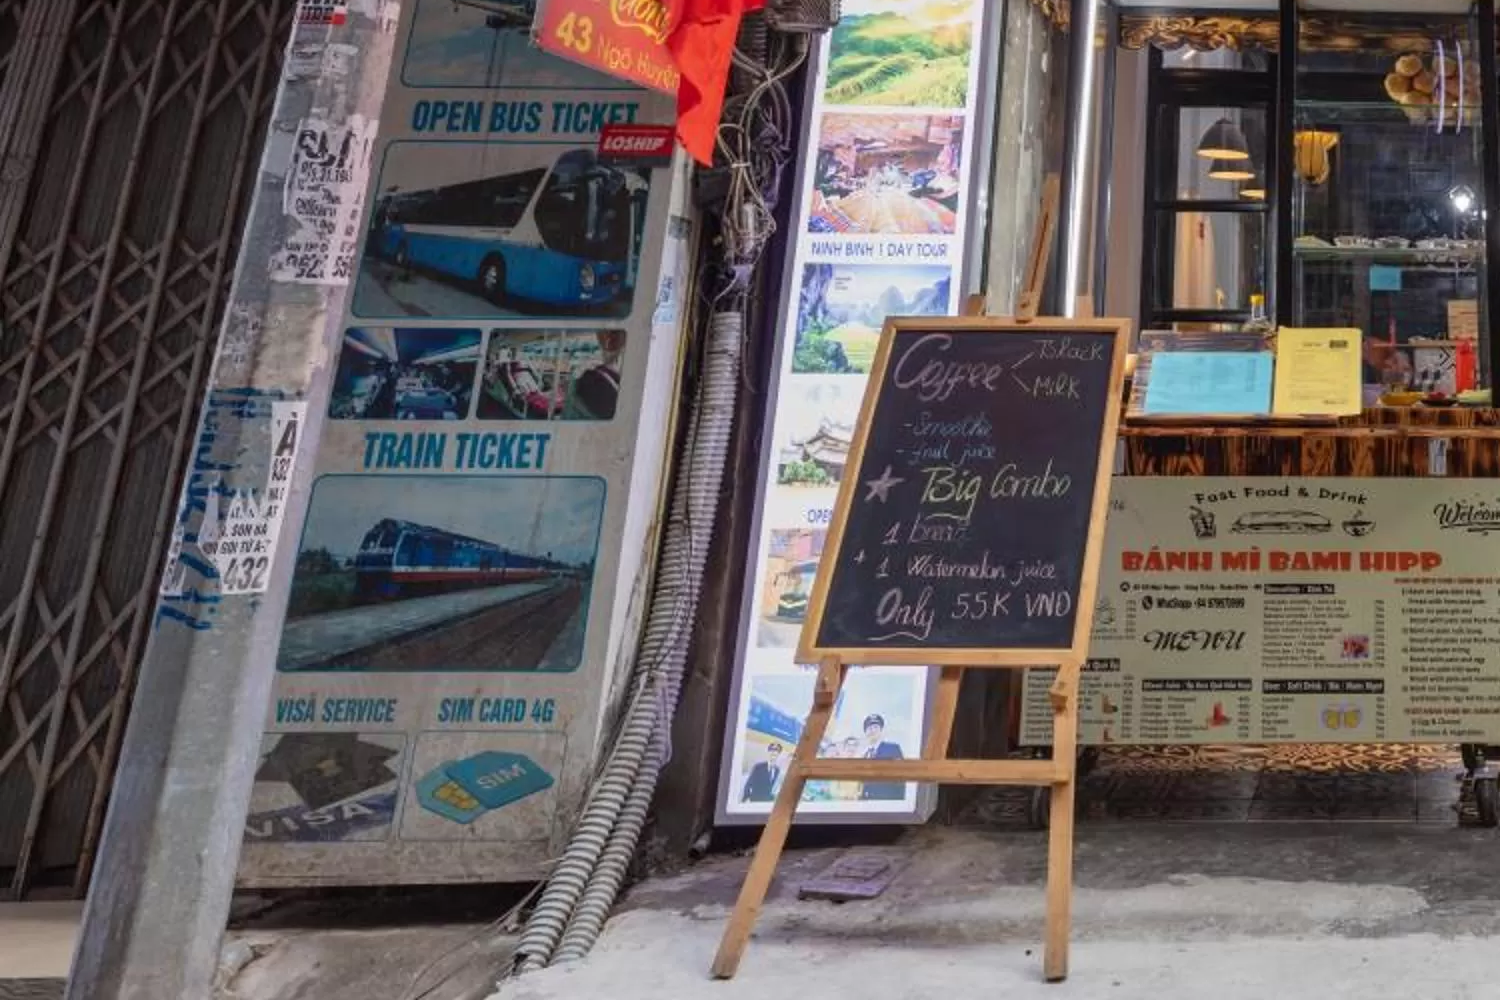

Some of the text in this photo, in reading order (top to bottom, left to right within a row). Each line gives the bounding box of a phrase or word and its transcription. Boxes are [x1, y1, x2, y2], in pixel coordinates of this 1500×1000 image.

[556, 11, 594, 54] 43
[412, 100, 639, 133] OPEN BUS TICKET
[811, 242, 842, 256] NINH
[845, 242, 874, 257] BINH
[887, 243, 916, 257] DAY
[916, 243, 948, 257] TOUR
[893, 333, 1003, 401] Coffee
[363, 432, 552, 469] TRAIN TICKET
[920, 457, 1072, 524] Big Combo
[1192, 489, 1237, 505] Fast
[1243, 484, 1290, 499] Food
[1319, 487, 1369, 506] Drink
[807, 509, 832, 524] OPE
[876, 557, 889, 579] 1
[907, 550, 1006, 581] Watermelon
[1011, 558, 1057, 586] juice
[1121, 545, 1213, 572] BÁNH
[876, 586, 1072, 638] Only 55K VND
[1143, 628, 1247, 652] MENU
[275, 697, 556, 724] VISA SERVICE SIM CARD 4G
[476, 761, 528, 791] SIM
